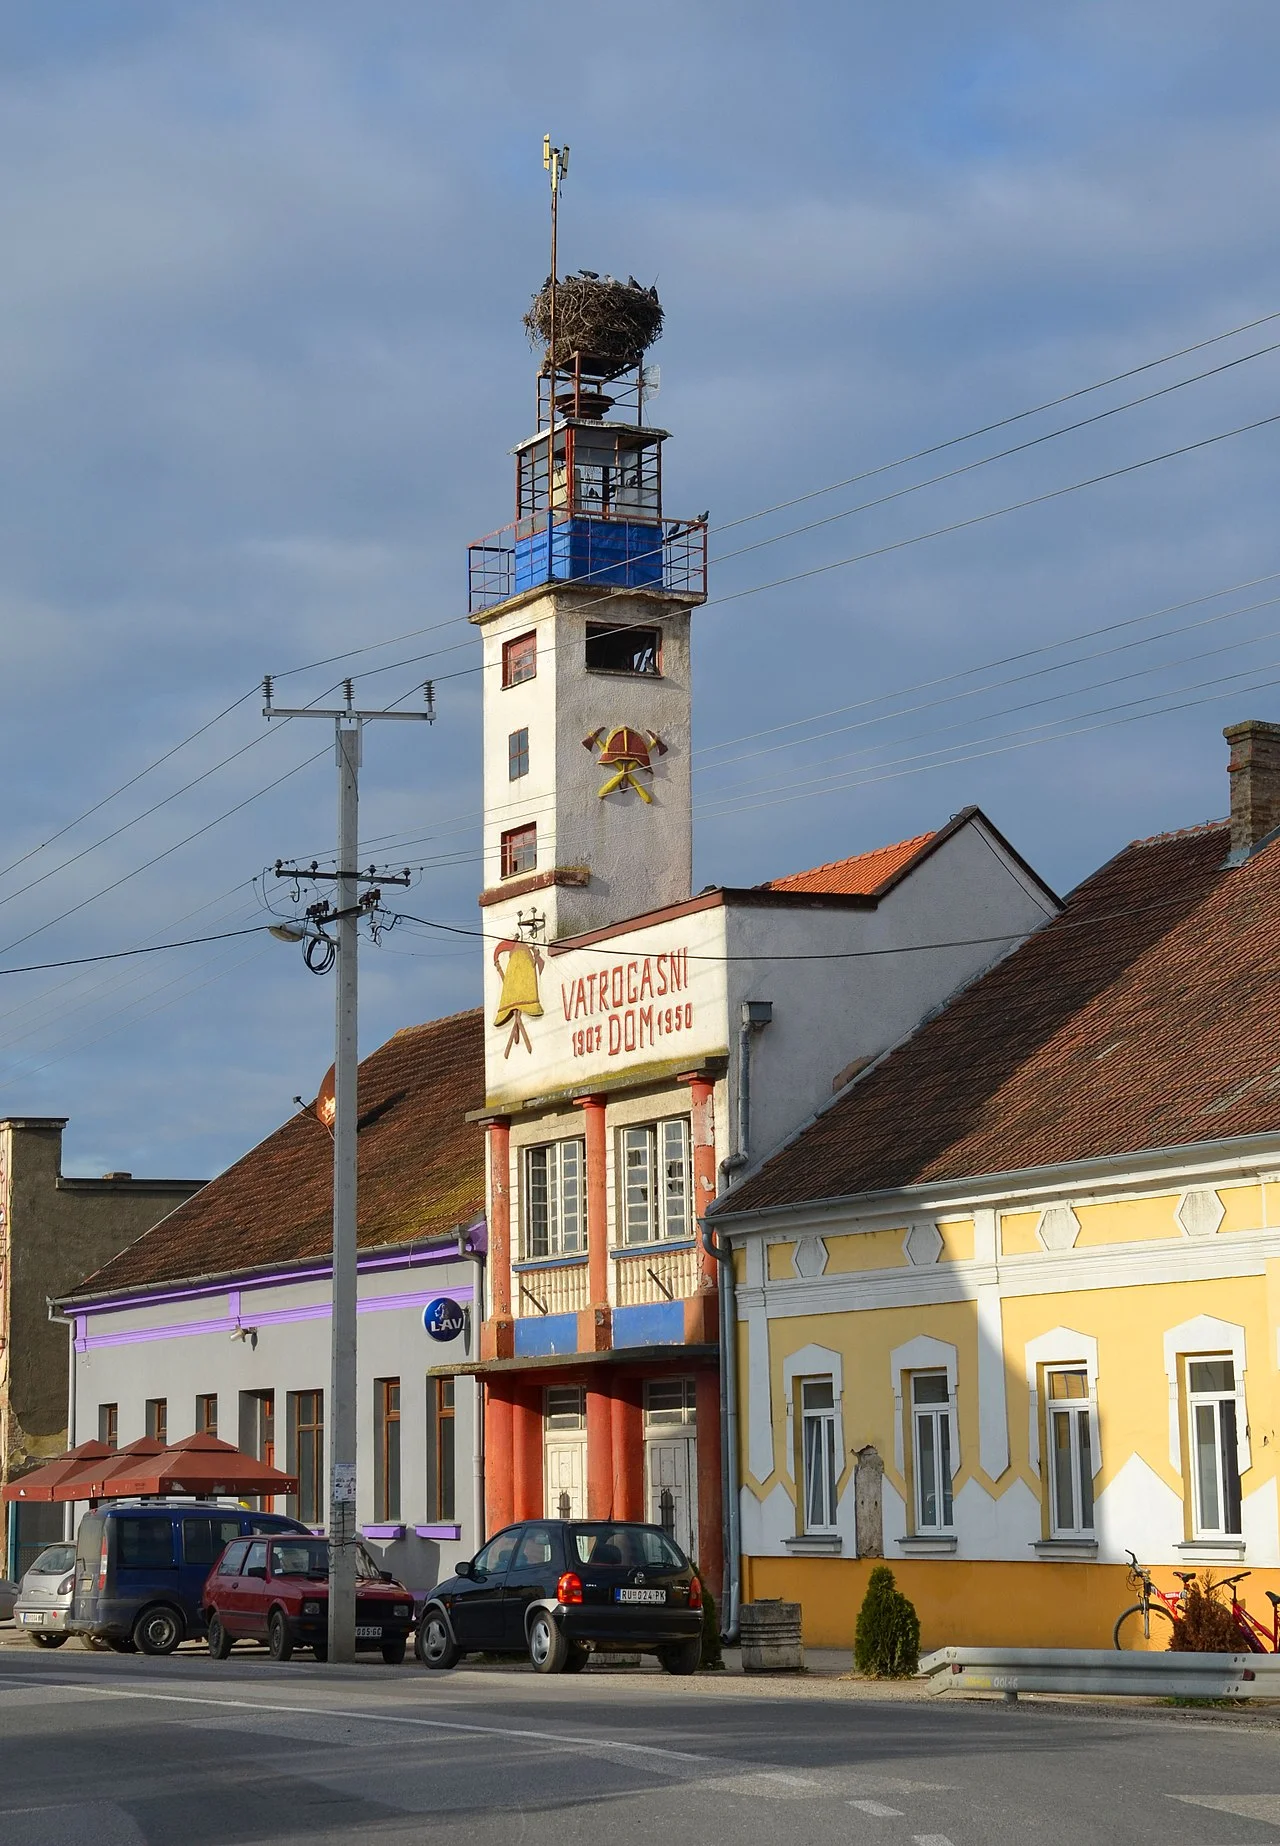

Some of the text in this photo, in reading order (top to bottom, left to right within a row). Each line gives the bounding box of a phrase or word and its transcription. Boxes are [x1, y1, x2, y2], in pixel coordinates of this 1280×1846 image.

[561, 946, 688, 1021] VATROGASNI
[572, 1002, 693, 1057] 1907 DOM 1950
[431, 1318, 462, 1331] LAV
